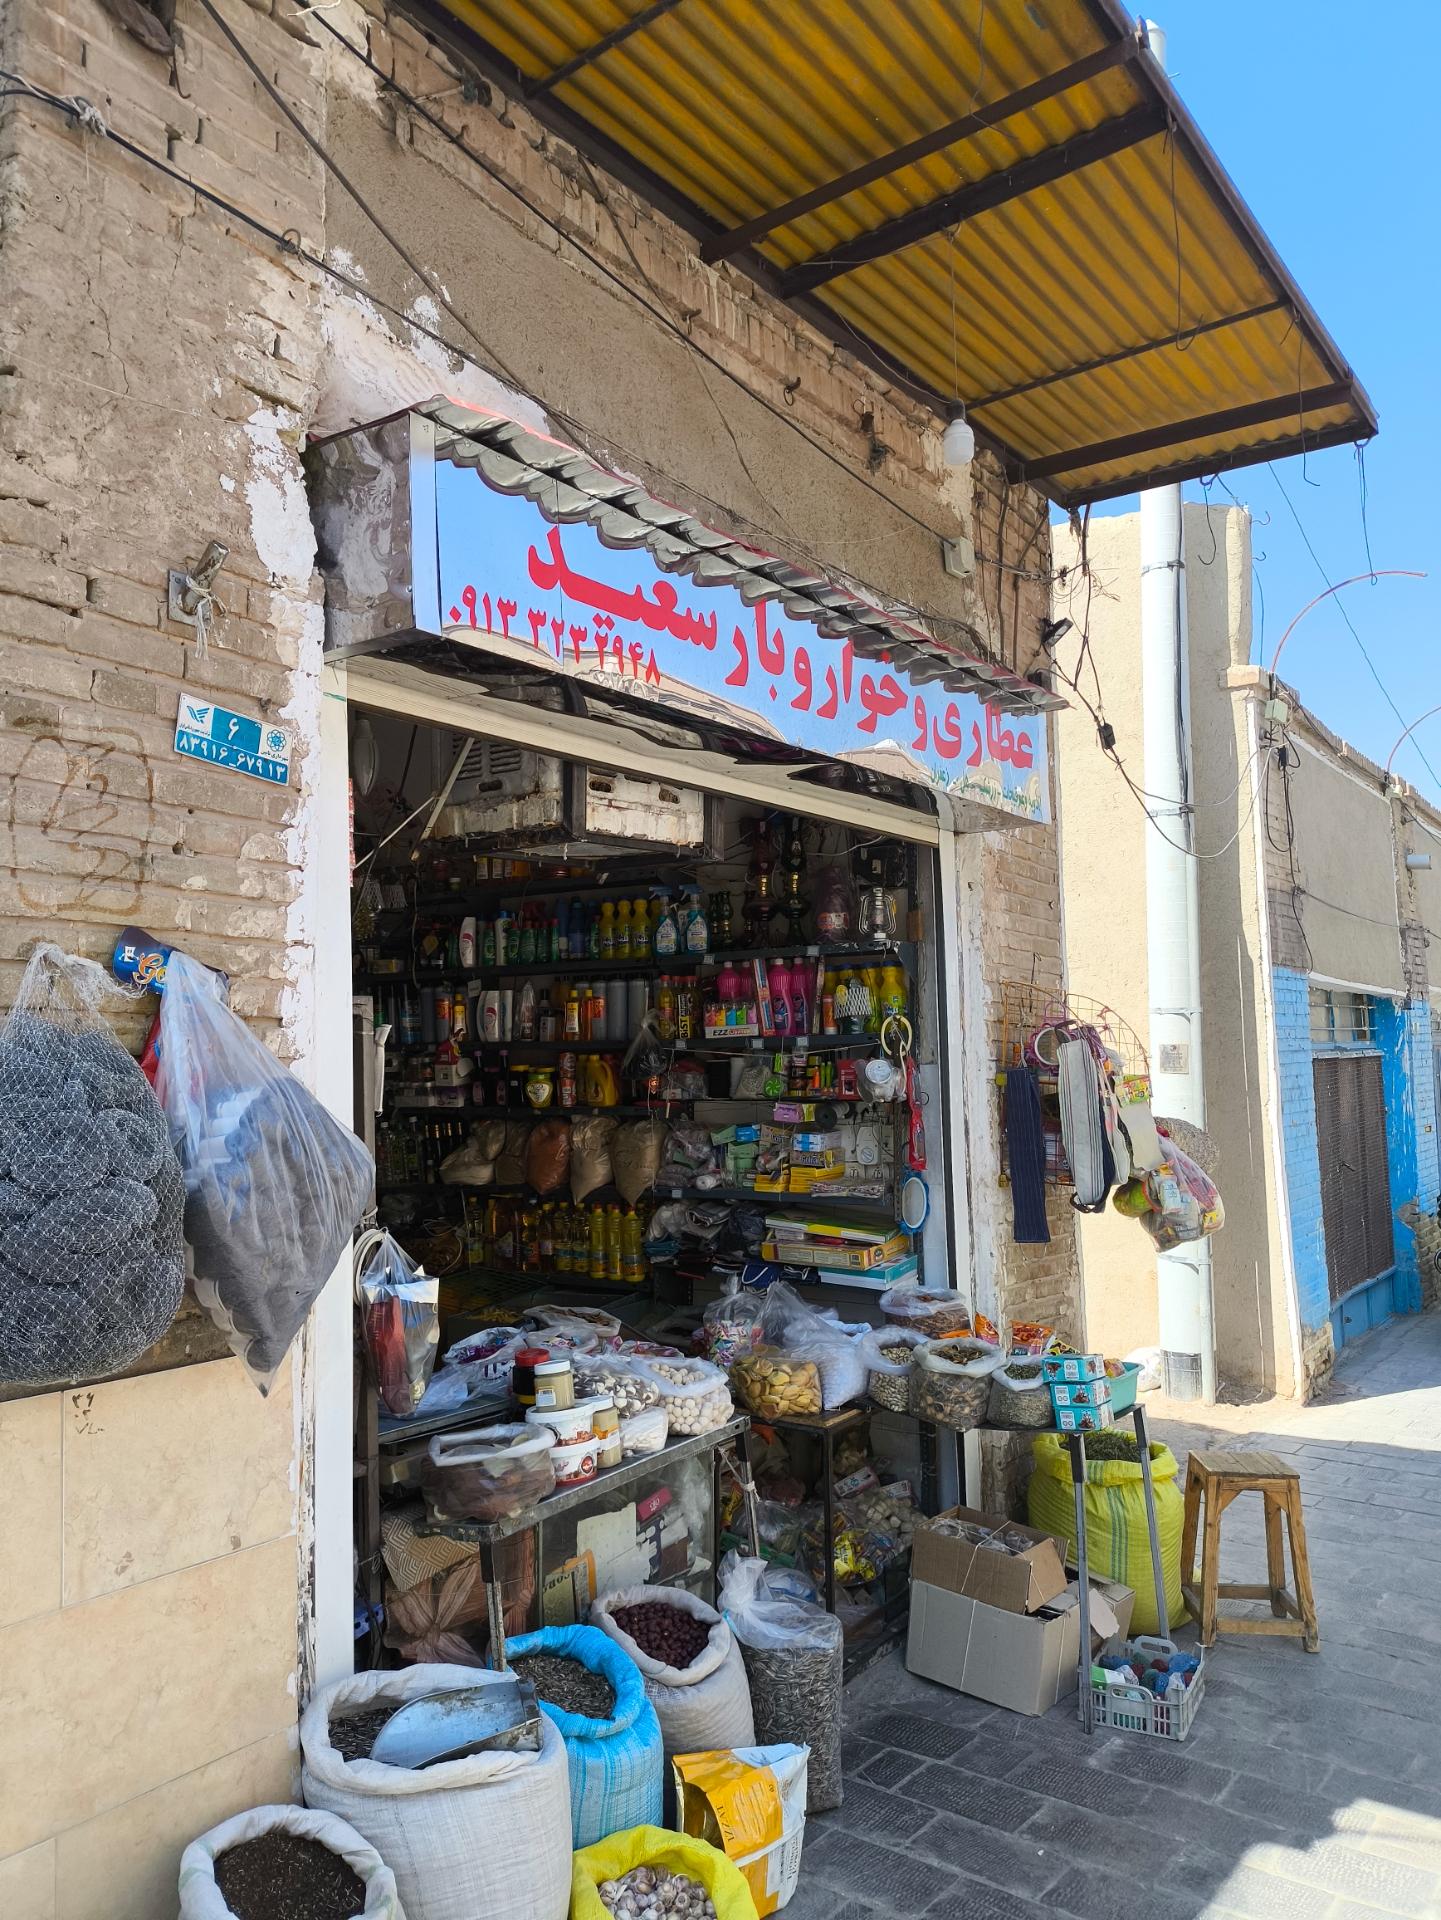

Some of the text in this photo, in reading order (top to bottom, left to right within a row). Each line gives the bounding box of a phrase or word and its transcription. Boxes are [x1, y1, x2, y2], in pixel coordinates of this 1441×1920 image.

[527, 524, 717, 650] سعید
[449, 585, 661, 686] ۰۹۱۳ ۳۲۳۲۹۴۸
[227, 717, 240, 741] ۶
[911, 695, 928, 751] و
[932, 700, 1033, 768] عطاری
